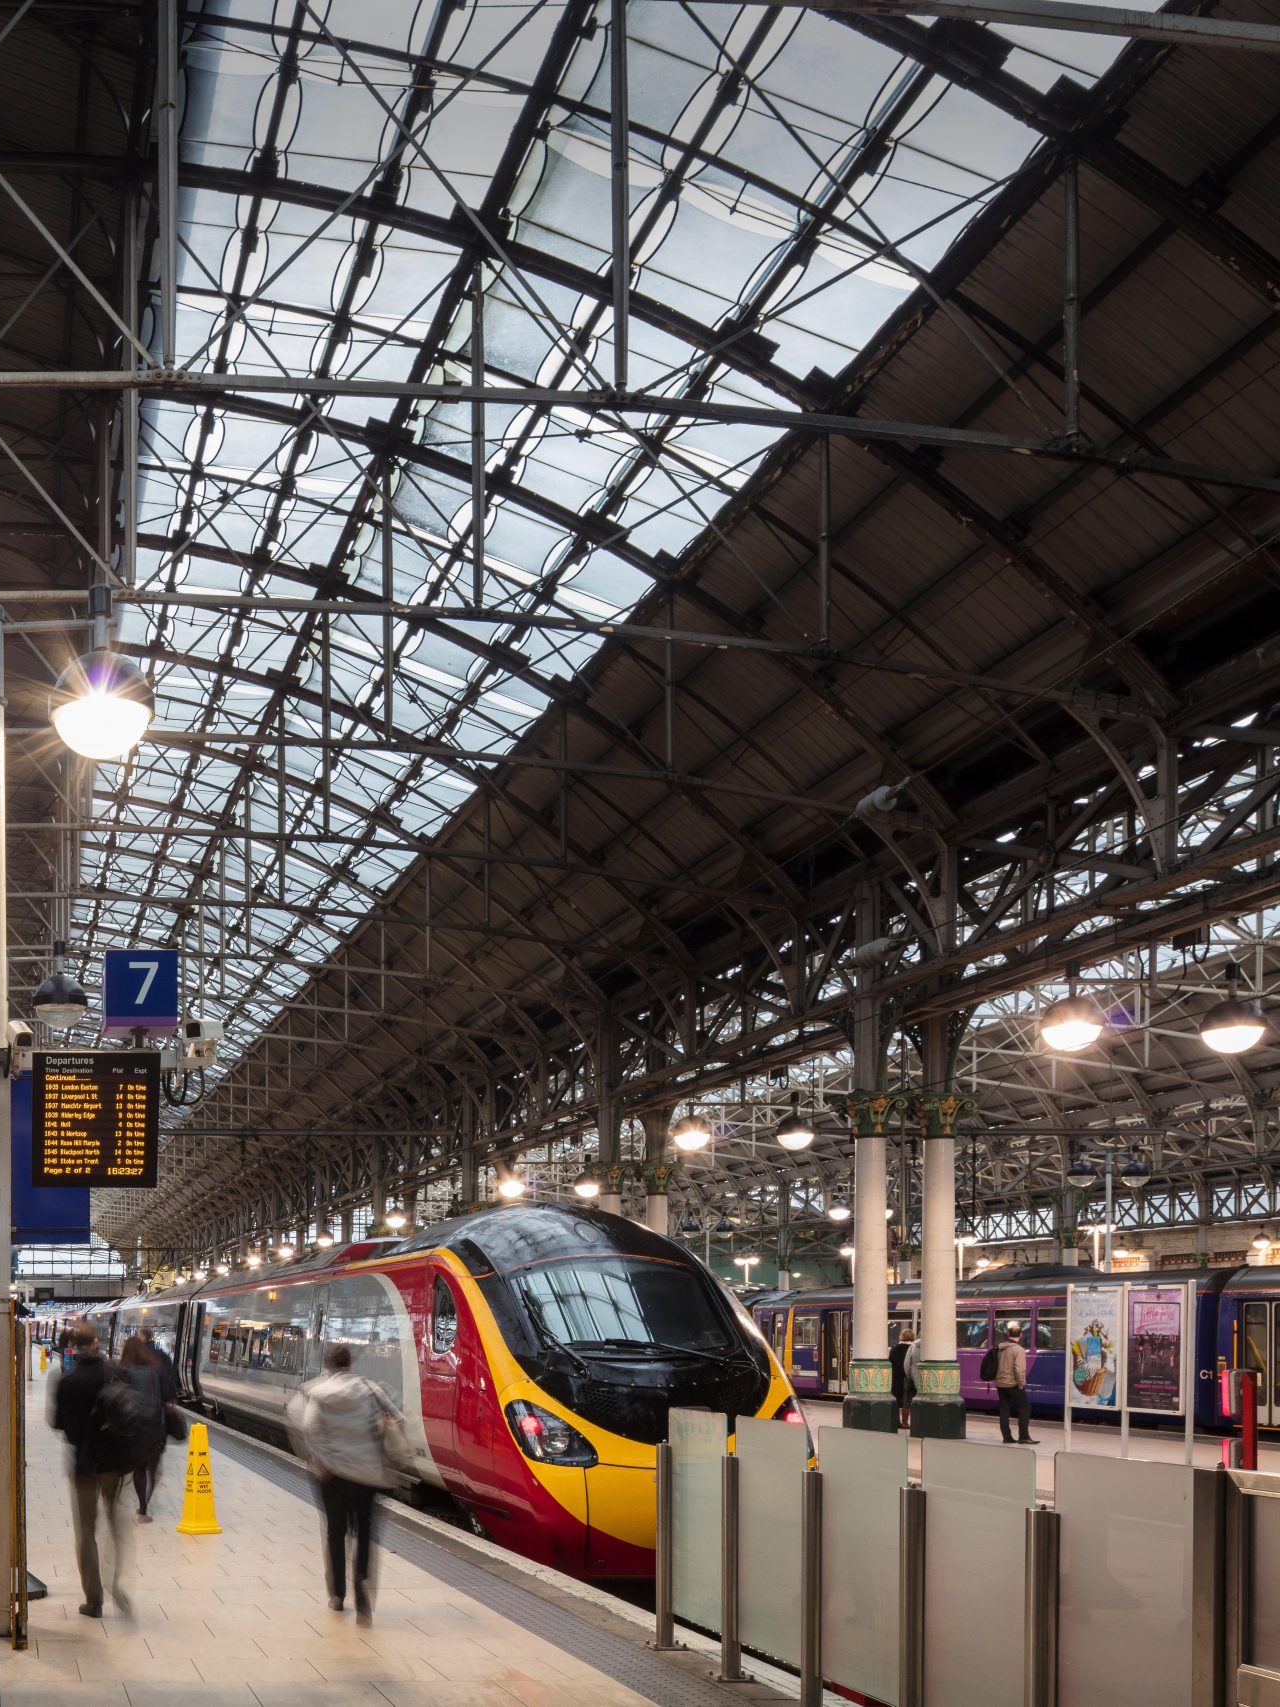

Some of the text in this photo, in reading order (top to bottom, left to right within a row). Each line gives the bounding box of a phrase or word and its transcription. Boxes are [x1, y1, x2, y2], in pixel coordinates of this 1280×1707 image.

[128, 961, 160, 1006] 7
[46, 1057, 94, 1066] Departures
[1199, 1369, 1214, 1380] C1
